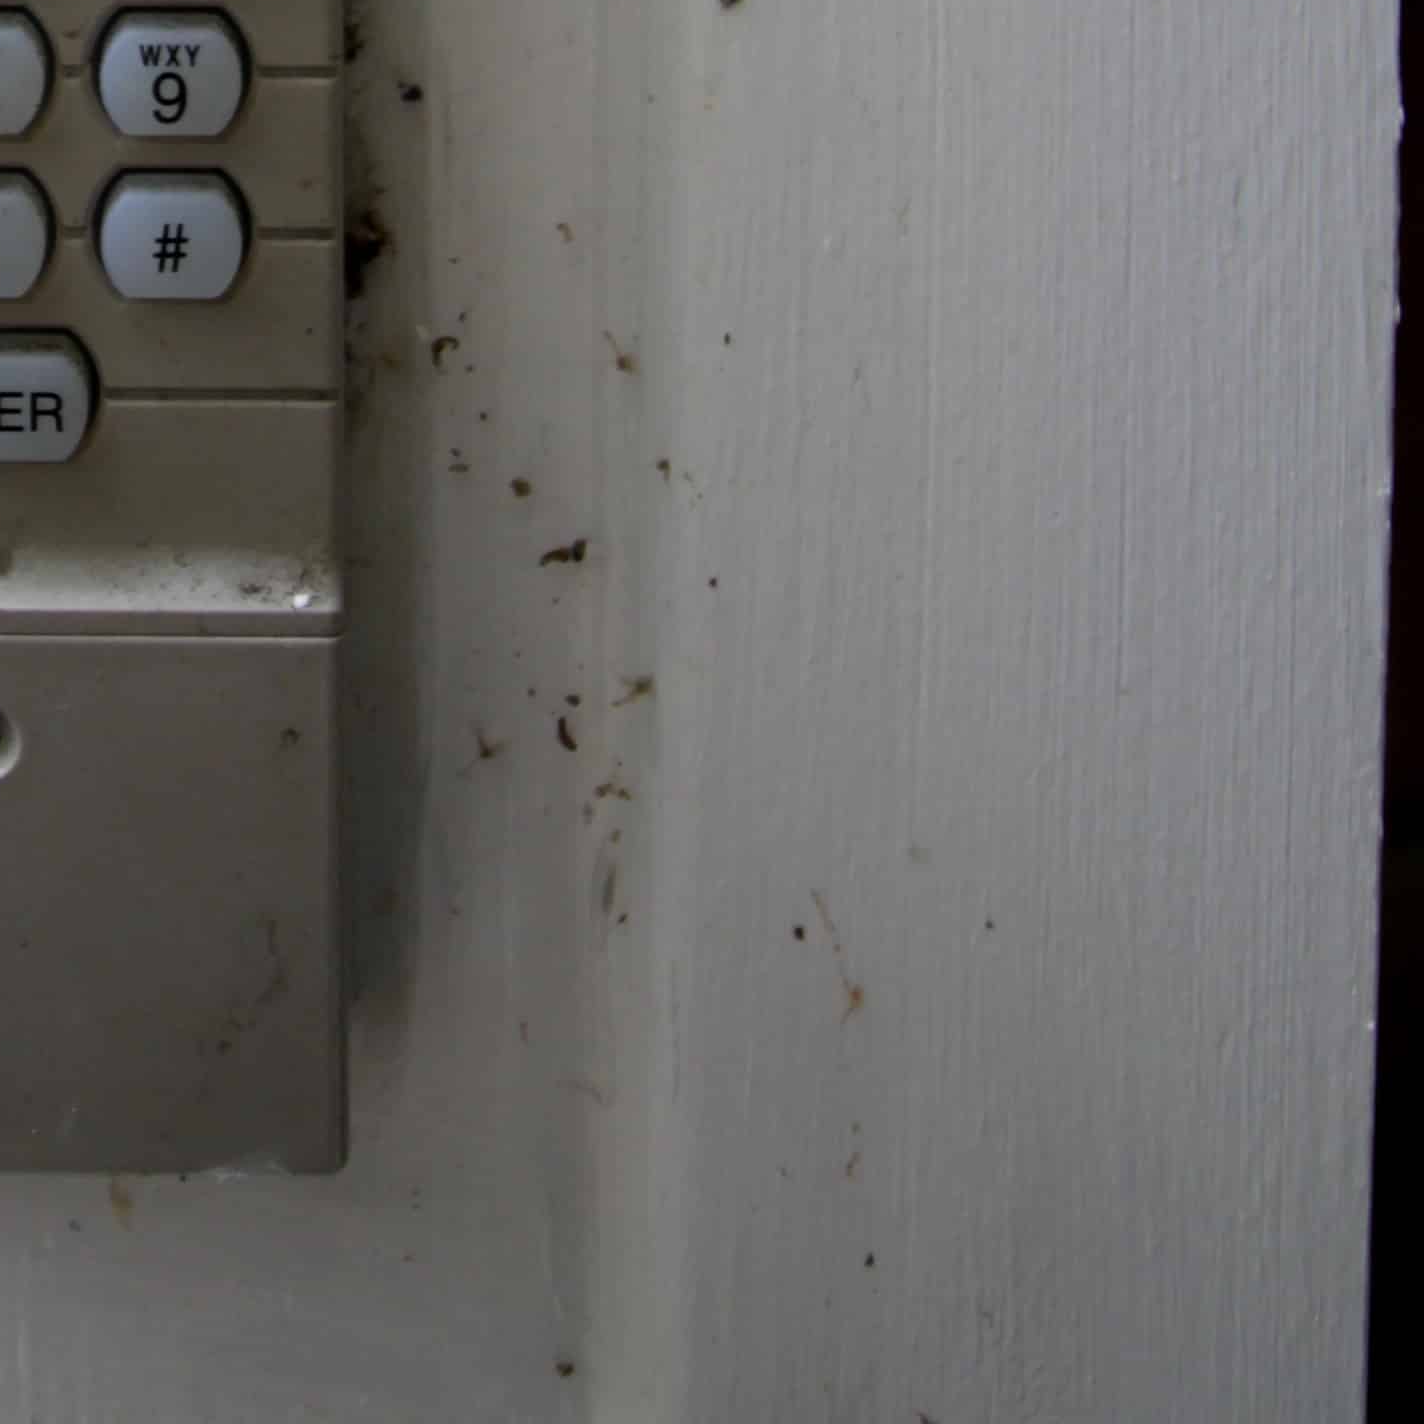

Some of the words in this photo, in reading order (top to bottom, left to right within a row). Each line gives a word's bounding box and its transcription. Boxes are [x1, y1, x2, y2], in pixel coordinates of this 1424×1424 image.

[140, 44, 201, 68] WXY
[152, 71, 188, 125] 9
[153, 223, 189, 273] #
